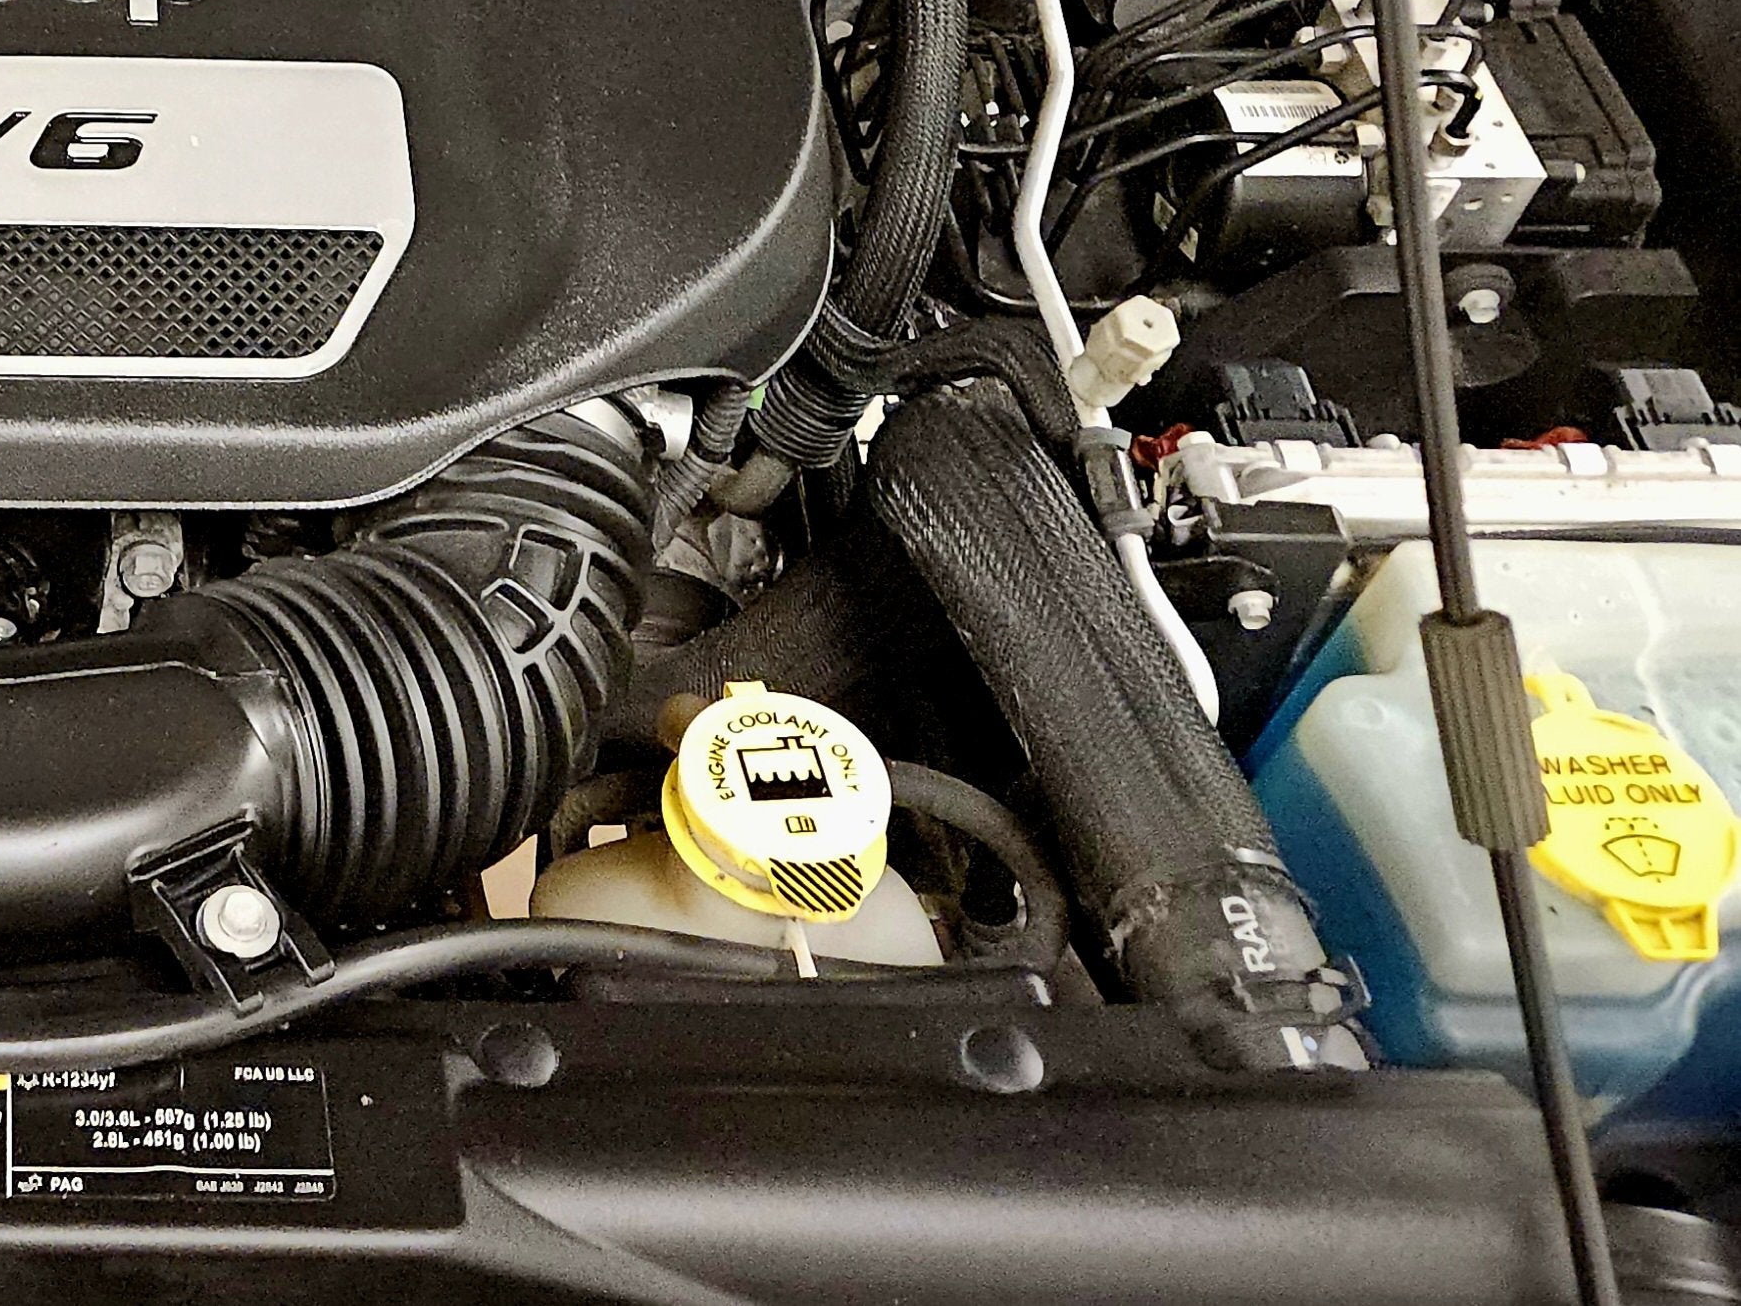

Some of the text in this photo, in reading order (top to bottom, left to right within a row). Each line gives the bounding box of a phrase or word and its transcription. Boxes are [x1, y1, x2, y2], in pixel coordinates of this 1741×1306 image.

[708, 711, 860, 800] ENGINE COOLANT ONLY
[1545, 783, 1702, 804] LUID ONLY
[1221, 896, 1276, 973] RAD
[42, 1070, 116, 1091] R-1234yf
[233, 1067, 263, 1081] FCA
[288, 1067, 315, 1082] LLC
[248, 1111, 272, 1132] lb)
[192, 1133, 234, 1152] (1.00
[238, 1133, 261, 1153] lb)
[50, 1177, 84, 1192] PAG
